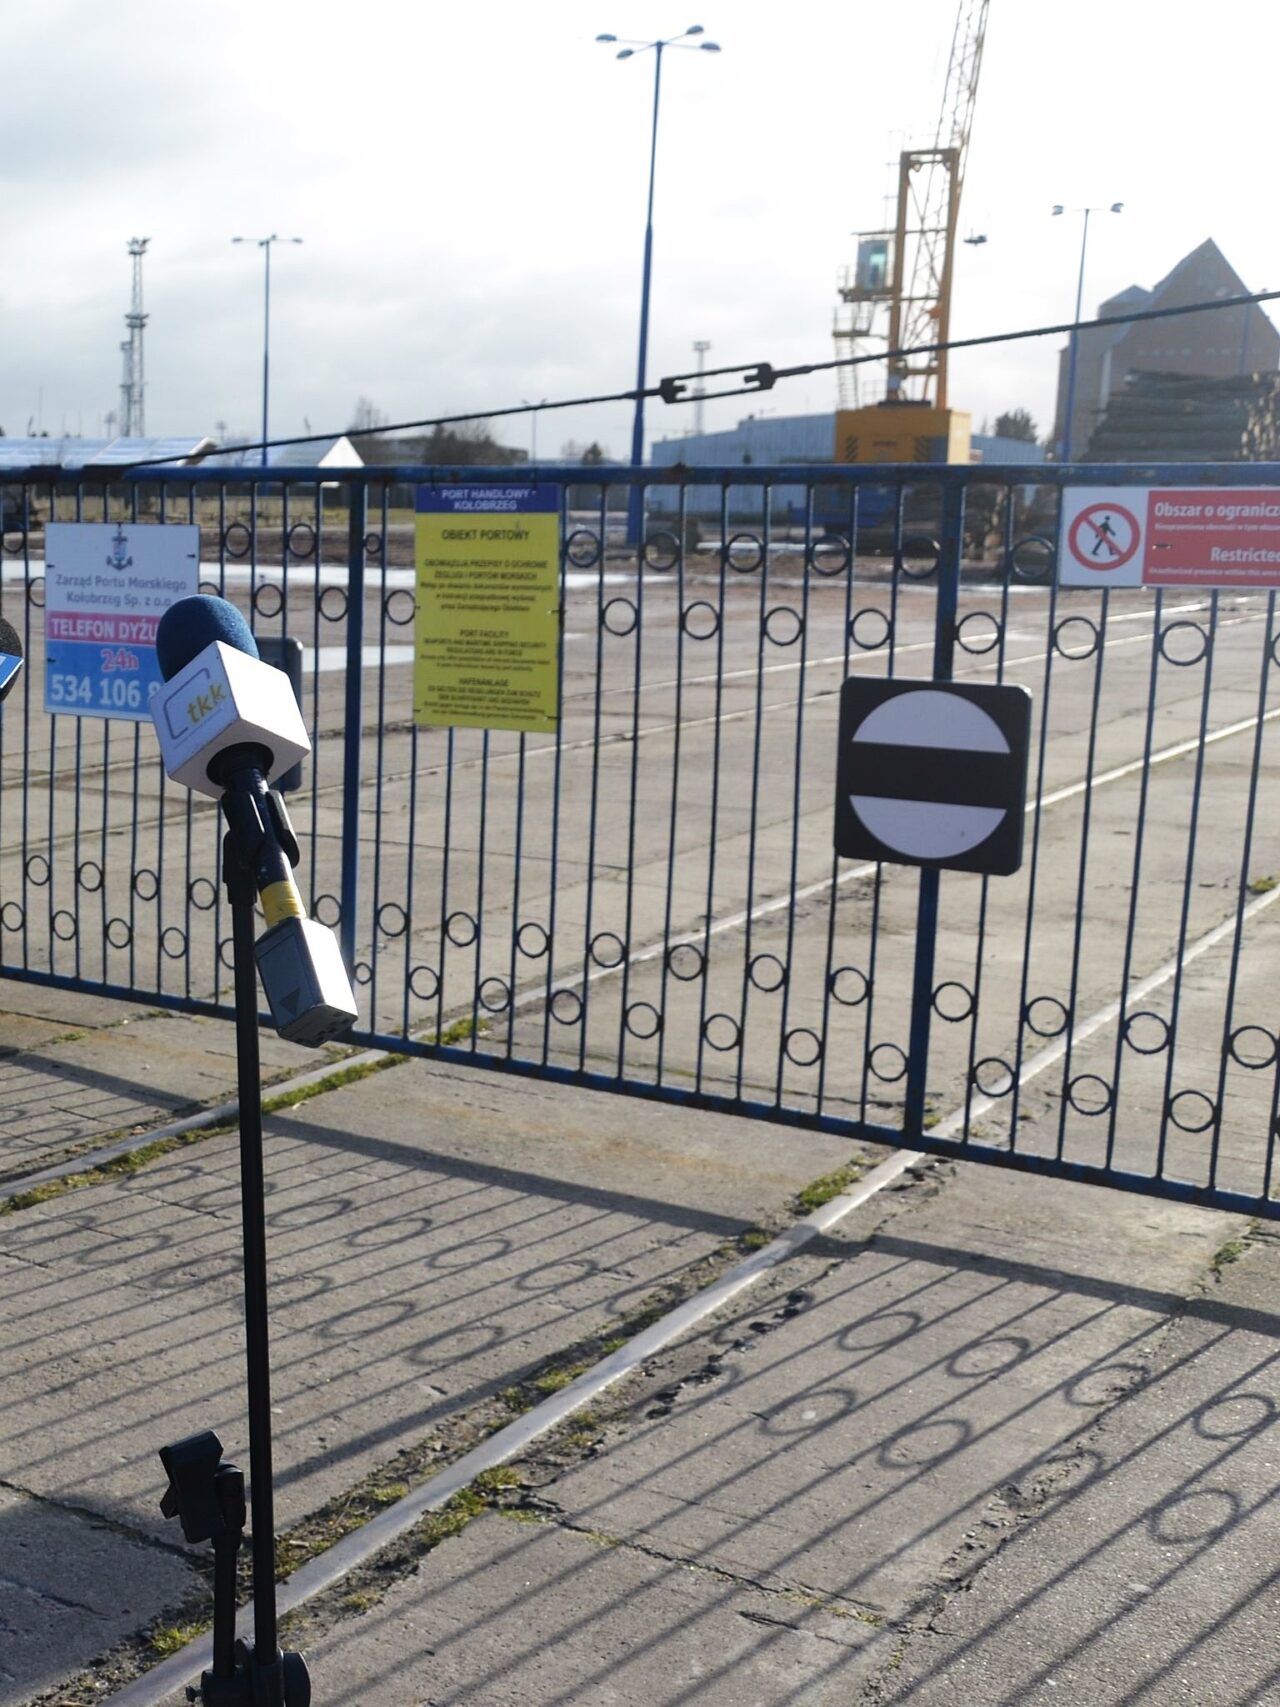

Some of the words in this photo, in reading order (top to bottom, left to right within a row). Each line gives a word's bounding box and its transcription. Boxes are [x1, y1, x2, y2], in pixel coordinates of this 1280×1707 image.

[441, 489, 469, 499] PORT
[471, 488, 531, 499] HANDLOWY
[1154, 501, 1203, 517] Obszar
[1204, 506, 1214, 517] o
[441, 529, 477, 540] OBIEKT
[480, 529, 531, 540] PORTOWY
[55, 574, 92, 589] Zarząd
[95, 575, 125, 589] Portu
[128, 577, 187, 595] Morskiego
[66, 591, 122, 607] Kołobrzeg
[124, 593, 141, 608] Sp.
[145, 597, 151, 606] z
[51, 618, 115, 638] TELEFON
[119, 618, 158, 641] DYŻU
[100, 648, 139, 672] 24h
[51, 674, 93, 705] 534
[100, 677, 141, 707] 106
[186, 682, 227, 724] tkk
